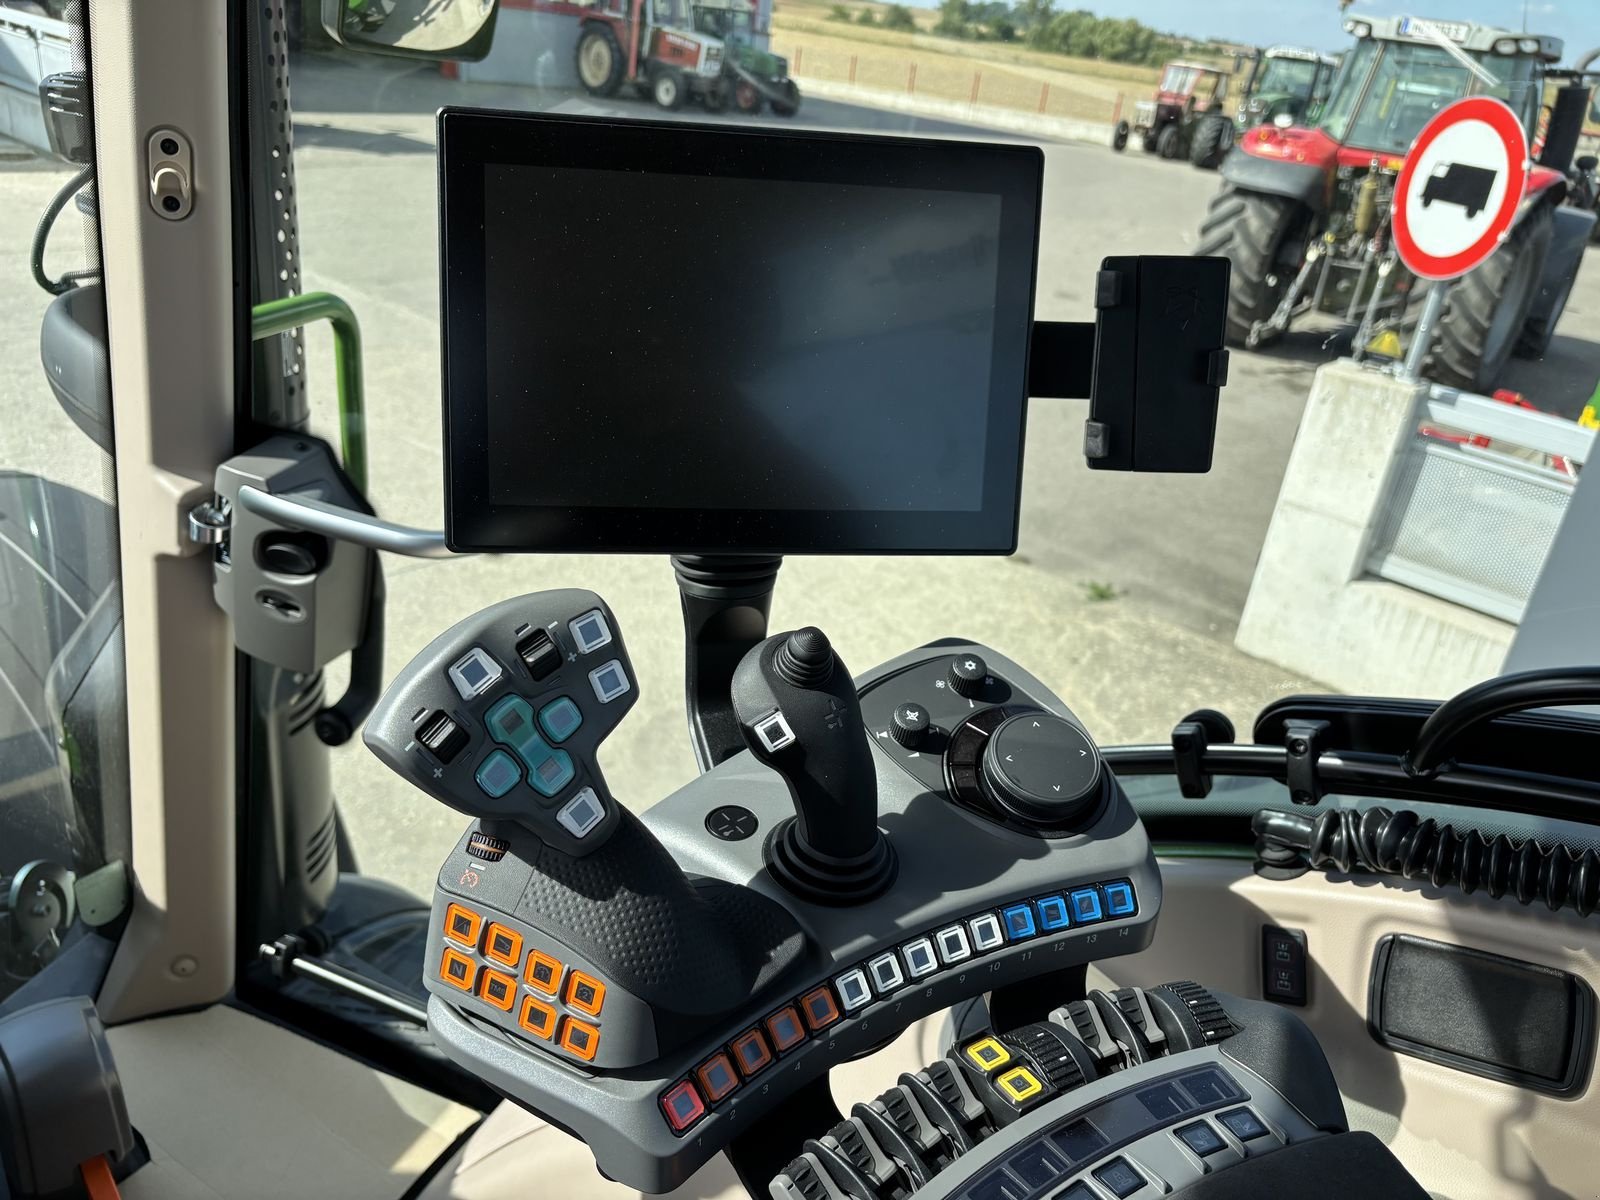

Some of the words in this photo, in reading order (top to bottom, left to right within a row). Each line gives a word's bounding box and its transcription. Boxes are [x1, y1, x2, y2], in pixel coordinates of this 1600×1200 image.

[1118, 927, 1129, 937] 14
[1086, 933, 1098, 944] 13
[1053, 941, 1065, 952] 12
[1021, 951, 1032, 961] 11
[452, 962, 464, 977] N
[988, 961, 1001, 973] 10
[959, 974, 966, 984] 9
[925, 988, 933, 998] 8
[861, 1020, 868, 1031] 6
[828, 1039, 836, 1050] 5
[762, 1083, 769, 1095] 3
[729, 1108, 736, 1121] 2
